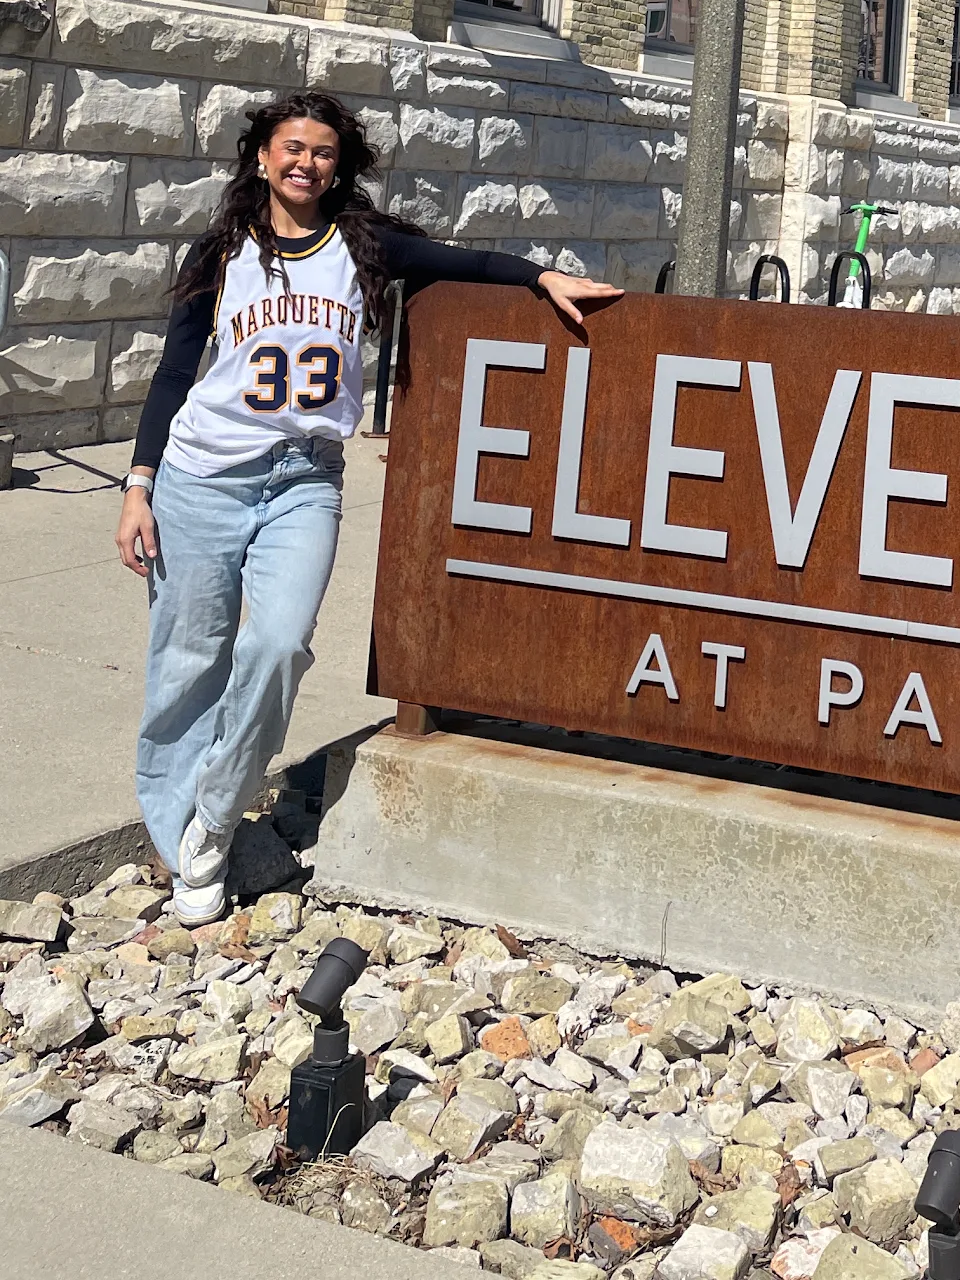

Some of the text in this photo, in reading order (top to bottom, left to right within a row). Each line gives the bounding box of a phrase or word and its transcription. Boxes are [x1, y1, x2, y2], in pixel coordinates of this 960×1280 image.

[229, 293, 357, 349] MARQUETTE
[243, 343, 343, 413] 33
[624, 633, 746, 709] AT
